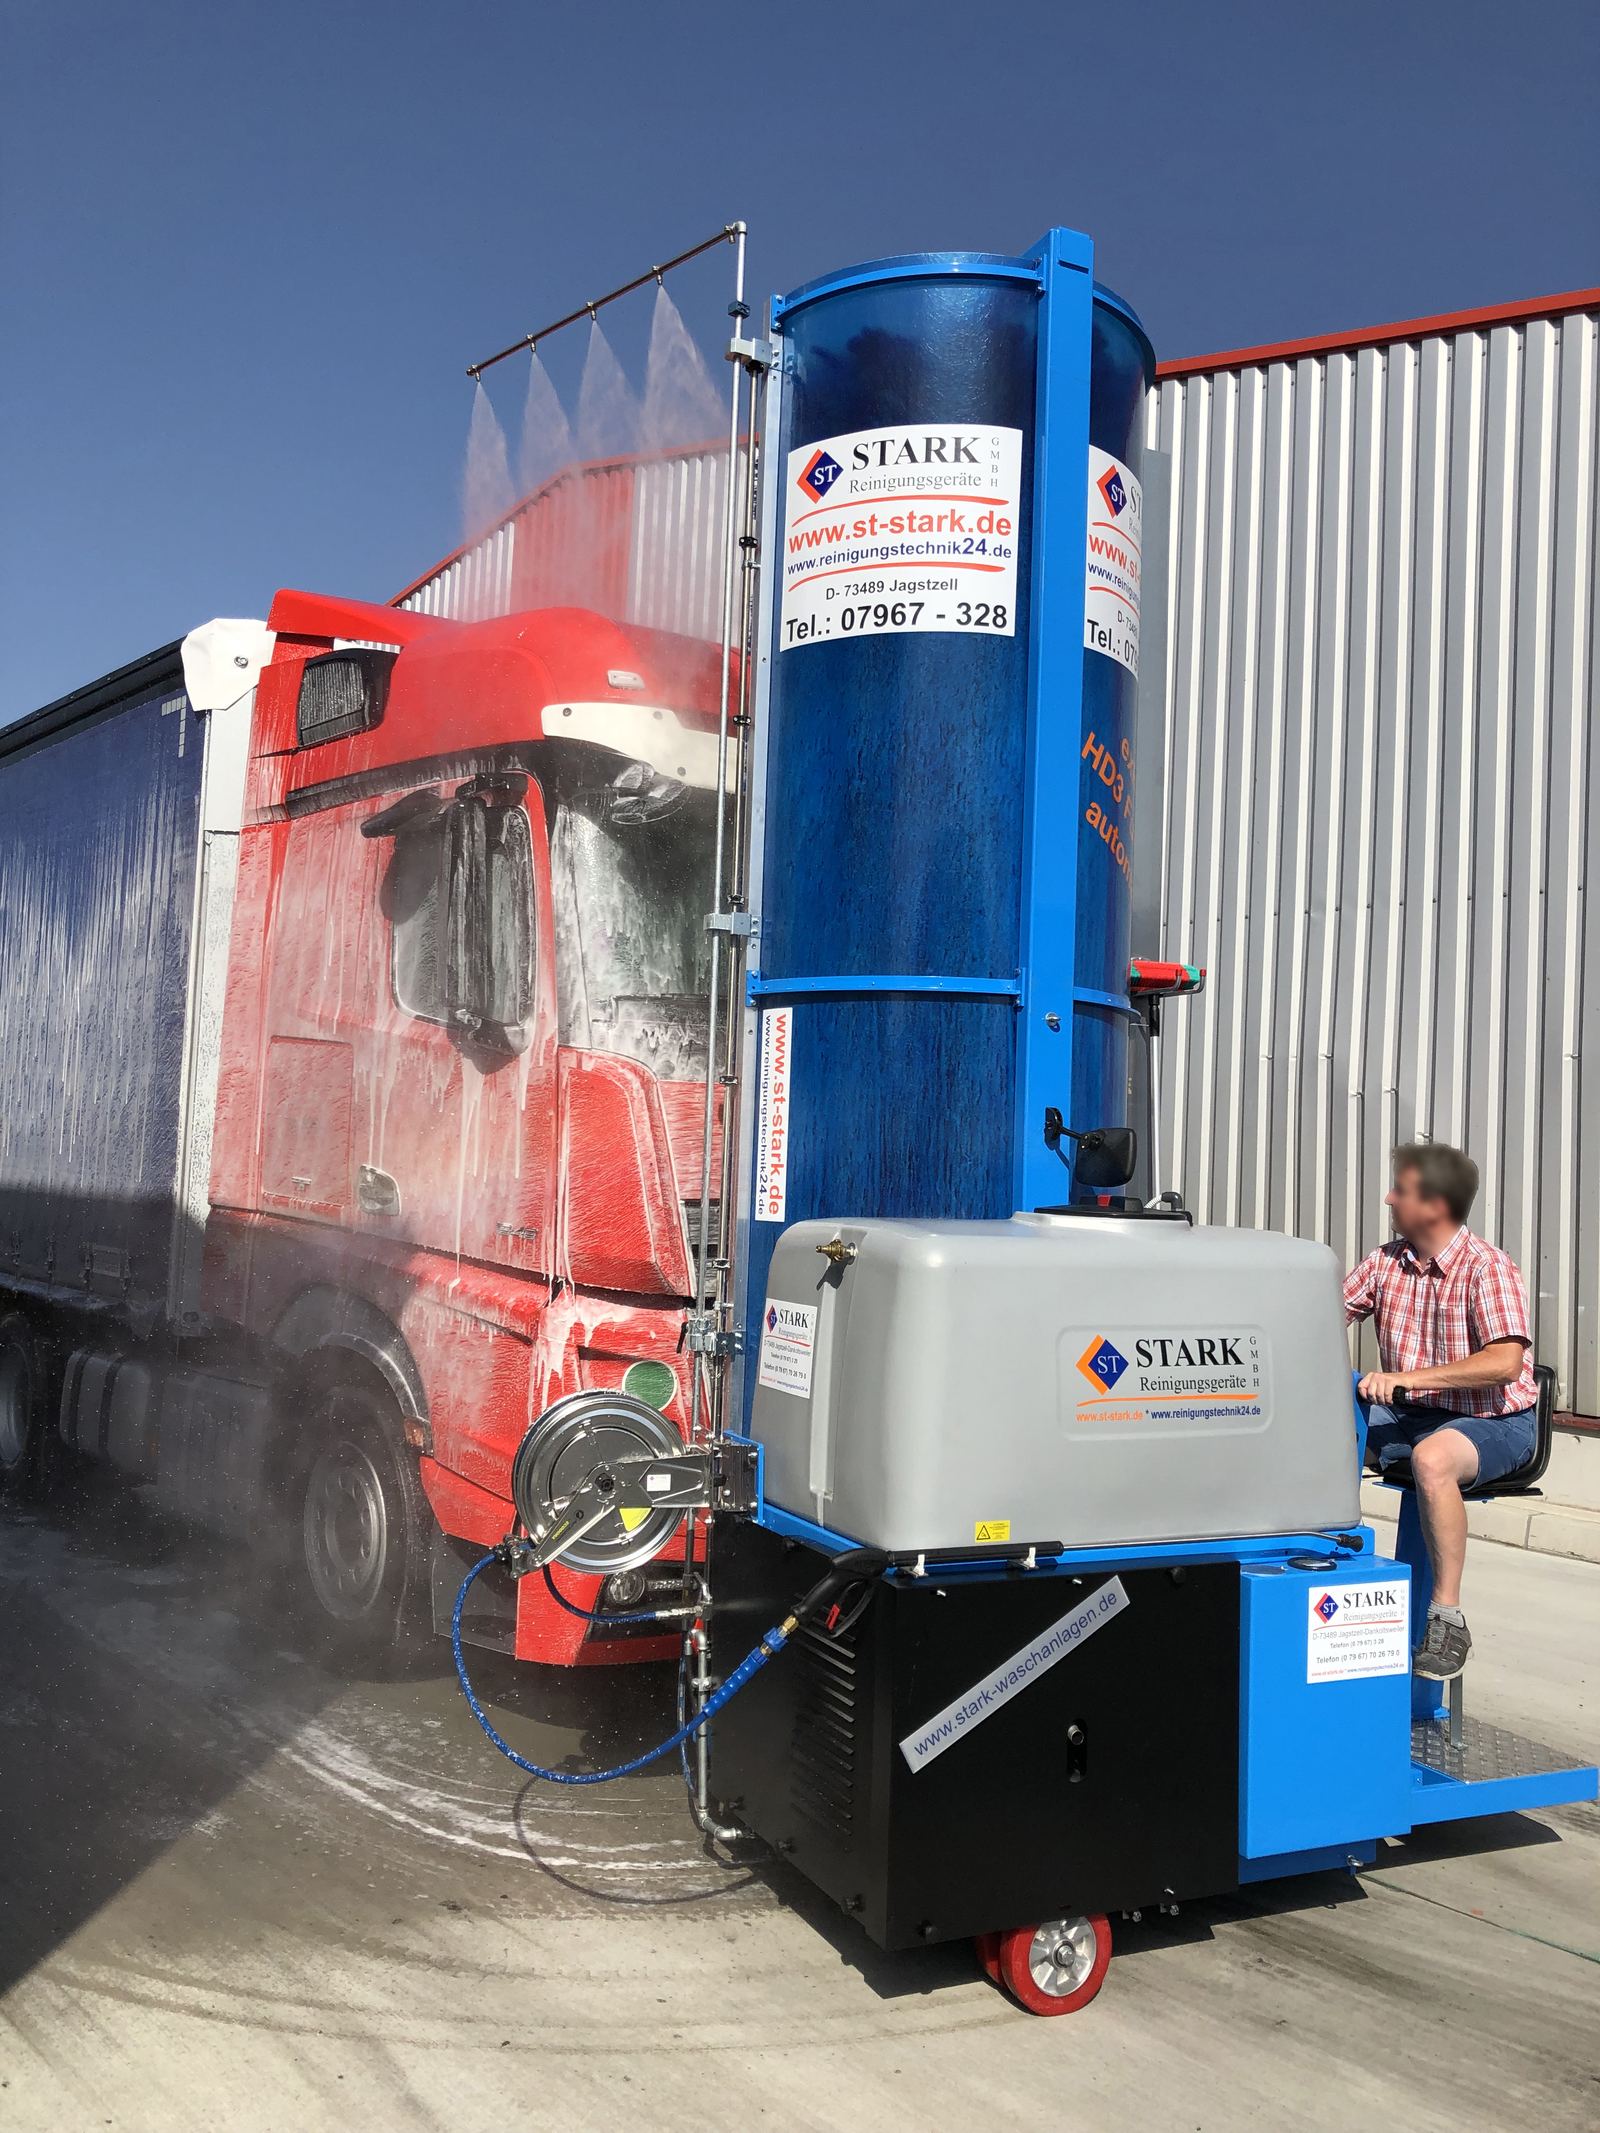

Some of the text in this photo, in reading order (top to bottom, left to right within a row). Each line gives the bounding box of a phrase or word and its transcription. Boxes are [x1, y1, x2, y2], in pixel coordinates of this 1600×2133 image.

[852, 436, 982, 472] STARK
[814, 464, 838, 486] ST
[849, 473, 982, 494] Reinigungsgeräte
[788, 509, 1012, 555] www.st-stark.de
[787, 537, 1012, 575] www.reinigungstechnik24.de
[844, 581, 884, 598] 73489
[889, 577, 959, 594] Jagstzell
[786, 614, 831, 643] Tel.:
[840, 602, 925, 632] 07967
[955, 603, 1008, 629] 328
[1087, 619, 1120, 656] Tel.:
[1081, 731, 1124, 803] HD3
[757, 1015, 771, 1215] www.reinigungstechnik24.de
[768, 1013, 787, 1215] www.st-stark.de
[779, 1308, 809, 1329] STARK
[1097, 1355, 1120, 1375] ST
[1135, 1337, 1245, 1368] STARK
[1140, 1375, 1247, 1394] Reinigungsgeräte
[1075, 1405, 1261, 1423] www.st-stark.de www.reinigungstechnik24.de
[1323, 1602, 1335, 1614] ST
[1342, 1589, 1397, 1609] STARK
[1316, 1655, 1339, 1664] Telefon
[914, 1591, 1117, 1756] www.stark-waschanlagen.de
